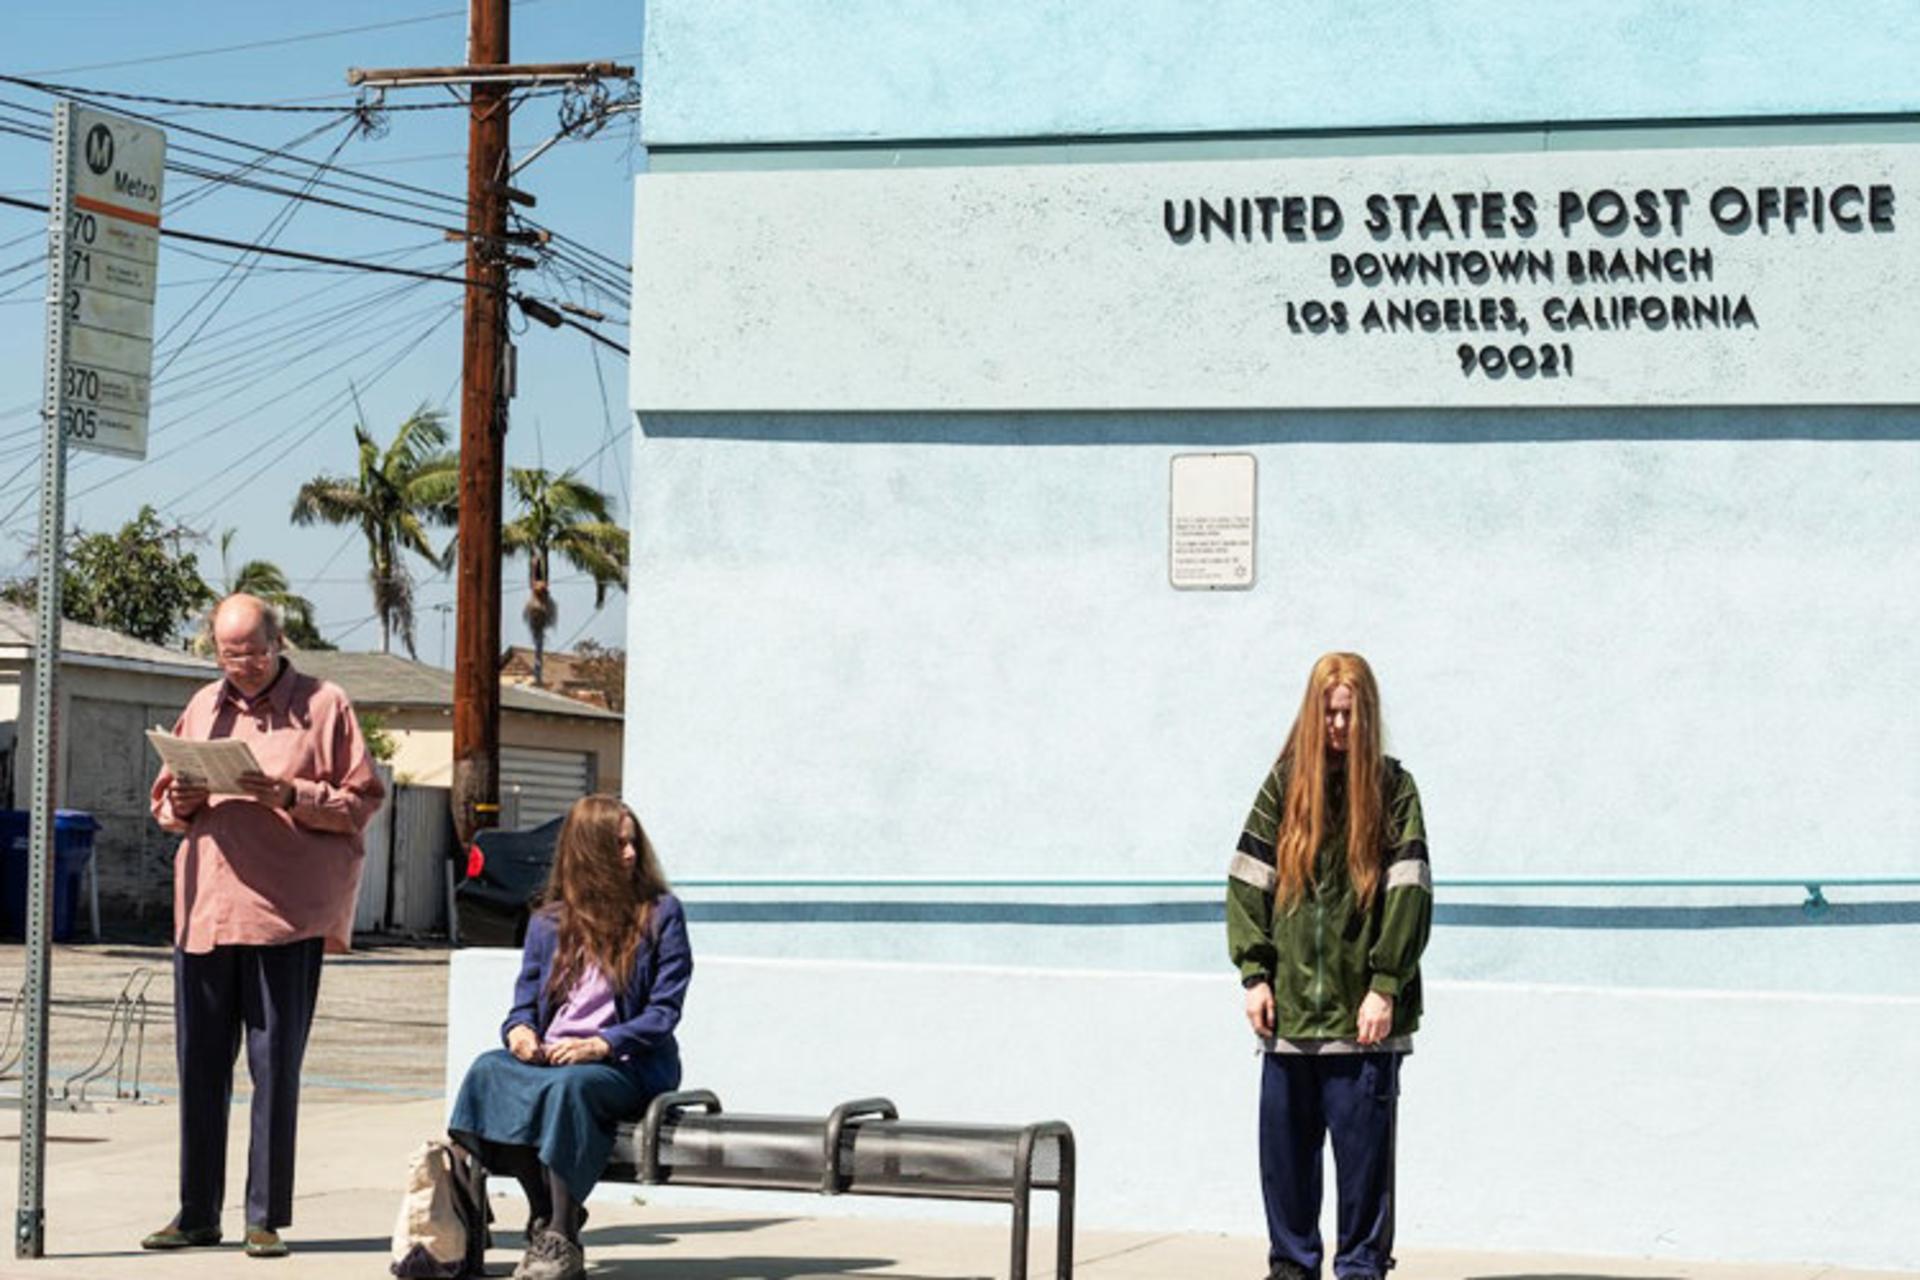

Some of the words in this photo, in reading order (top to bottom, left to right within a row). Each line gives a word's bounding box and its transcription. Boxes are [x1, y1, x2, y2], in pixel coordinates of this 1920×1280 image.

[114, 170, 157, 202] Metro
[73, 211, 96, 244] 70
[1164, 196, 1343, 243] UNITED
[1365, 191, 1537, 240] STATES
[1559, 189, 1689, 237] POST
[1710, 184, 1895, 235] OFFICE
[72, 250, 90, 282] 71
[1331, 250, 1554, 286] DOWNTOWN
[1567, 248, 1713, 284] BRANCH
[1286, 299, 1348, 335] LOS
[1361, 297, 1529, 335] ANGELES,
[1543, 295, 1757, 331] CALIFORNIA
[1457, 343, 1572, 377] 90021
